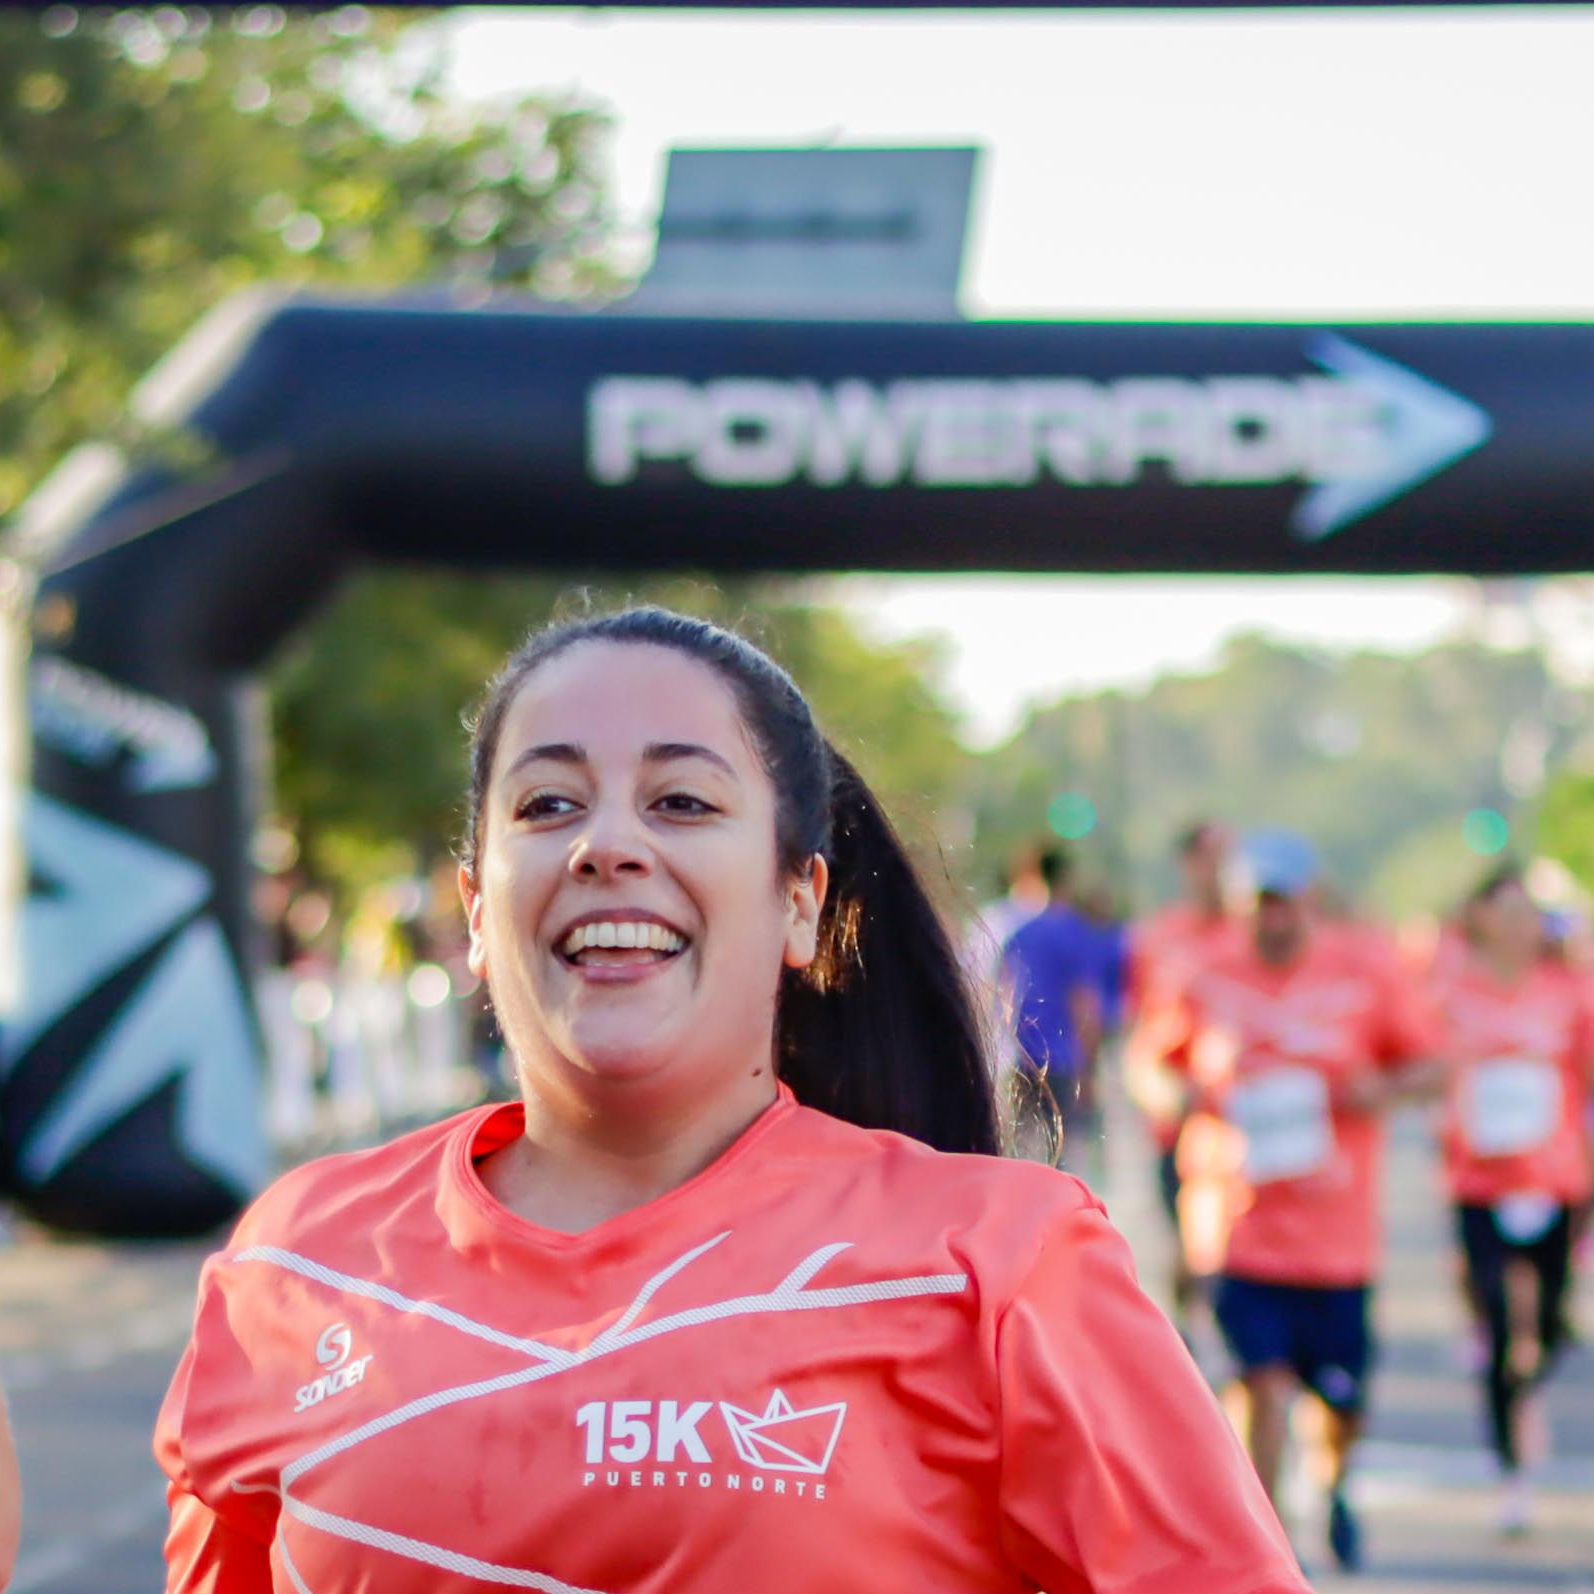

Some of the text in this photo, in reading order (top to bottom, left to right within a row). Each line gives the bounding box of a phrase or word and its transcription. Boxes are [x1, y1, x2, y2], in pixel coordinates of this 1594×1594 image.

[576, 1400, 714, 1464] 15K
[584, 1471, 825, 1499] PUERTO NORTE
